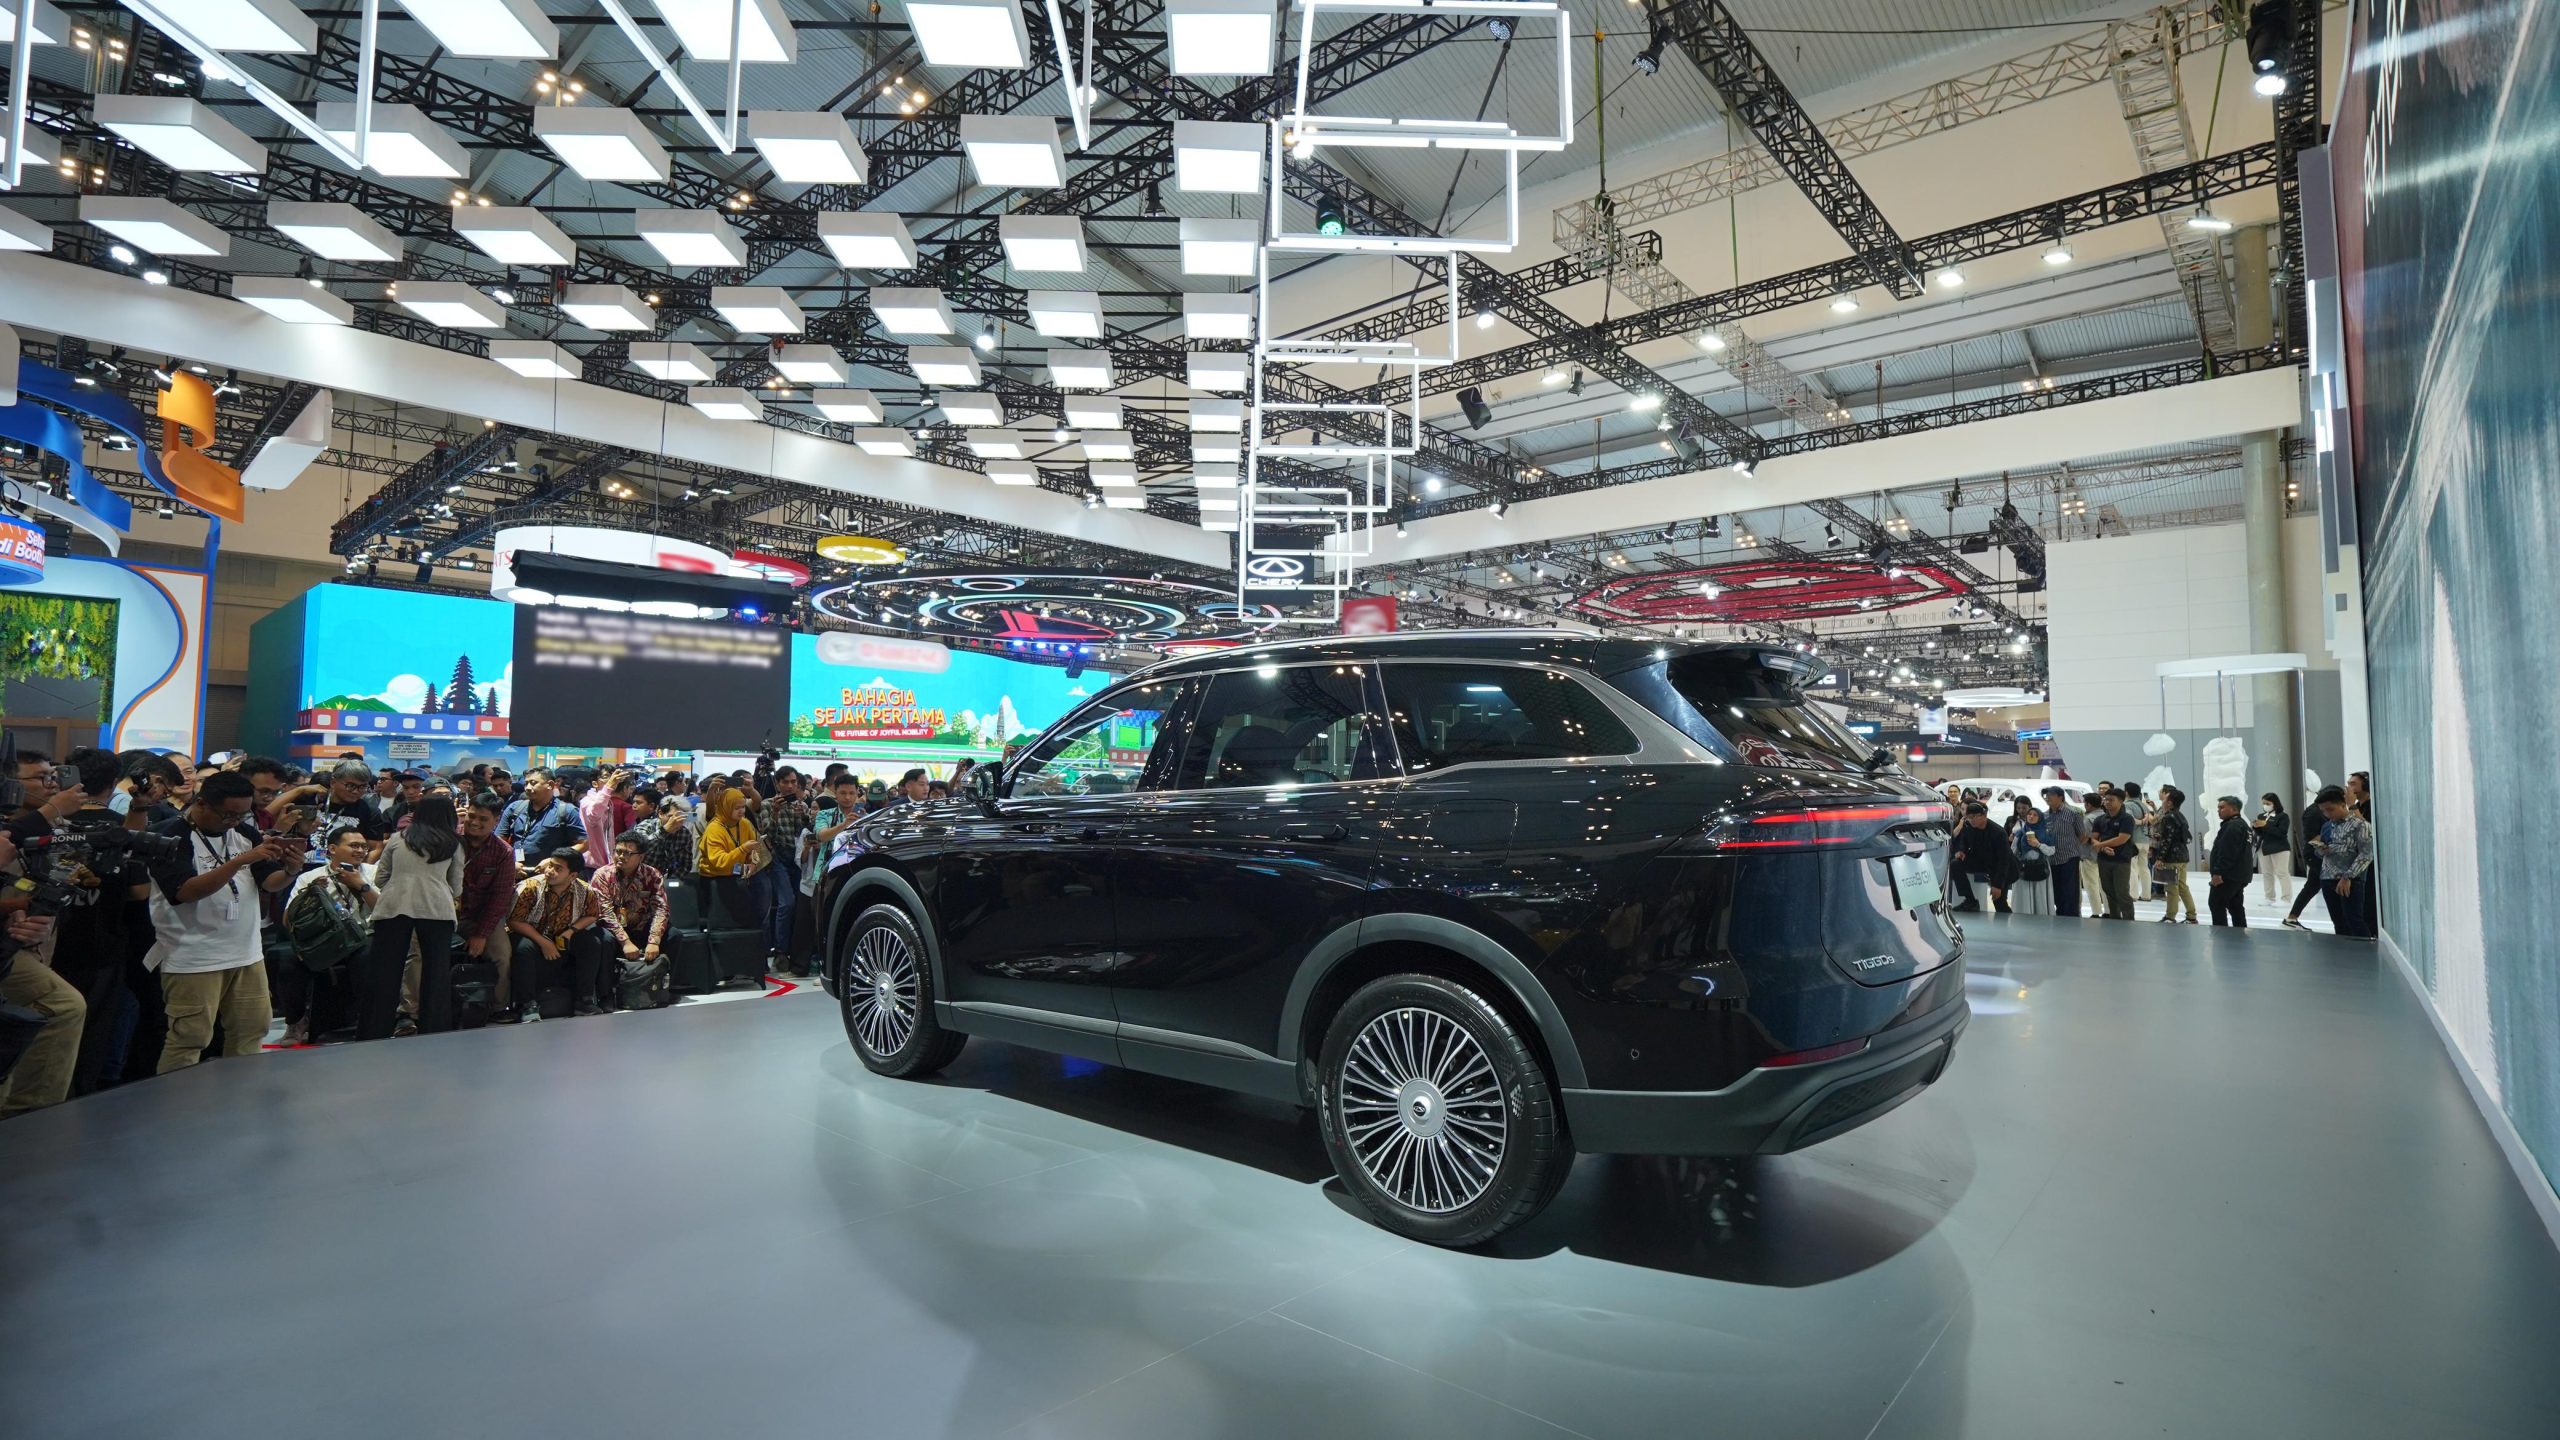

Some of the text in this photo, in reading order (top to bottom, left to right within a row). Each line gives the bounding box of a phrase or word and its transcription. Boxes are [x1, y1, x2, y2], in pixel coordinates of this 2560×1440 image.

[1247, 578, 1304, 586] CHERY
[841, 687, 916, 706] BAHAGIA
[814, 707, 946, 726] SEJAK PERTAMA
[869, 729, 878, 737] OF
[880, 729, 901, 737] JOYFUL
[902, 728, 928, 736] MOBILITY
[51, 834, 86, 843] RONIN
